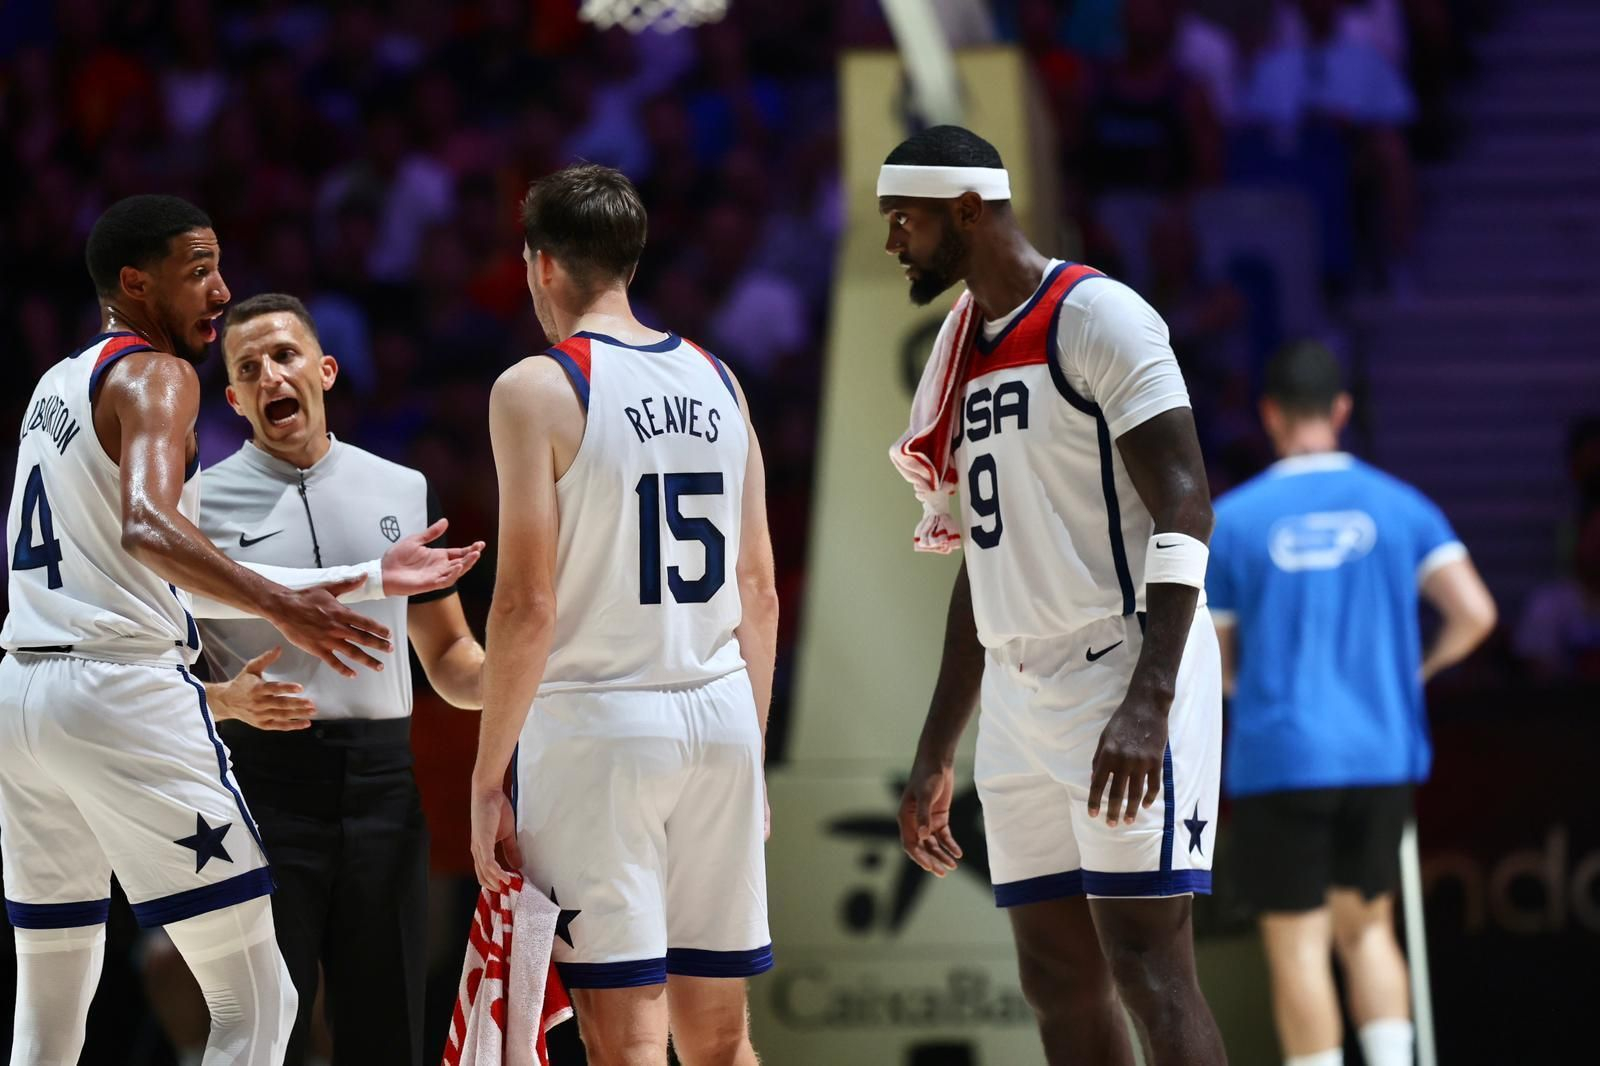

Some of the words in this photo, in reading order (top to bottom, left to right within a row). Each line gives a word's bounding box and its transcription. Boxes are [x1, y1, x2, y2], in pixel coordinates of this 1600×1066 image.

[624, 396, 721, 444] REAVES
[12, 463, 63, 590] 4
[635, 471, 726, 604] 15
[968, 453, 1004, 550] 9
